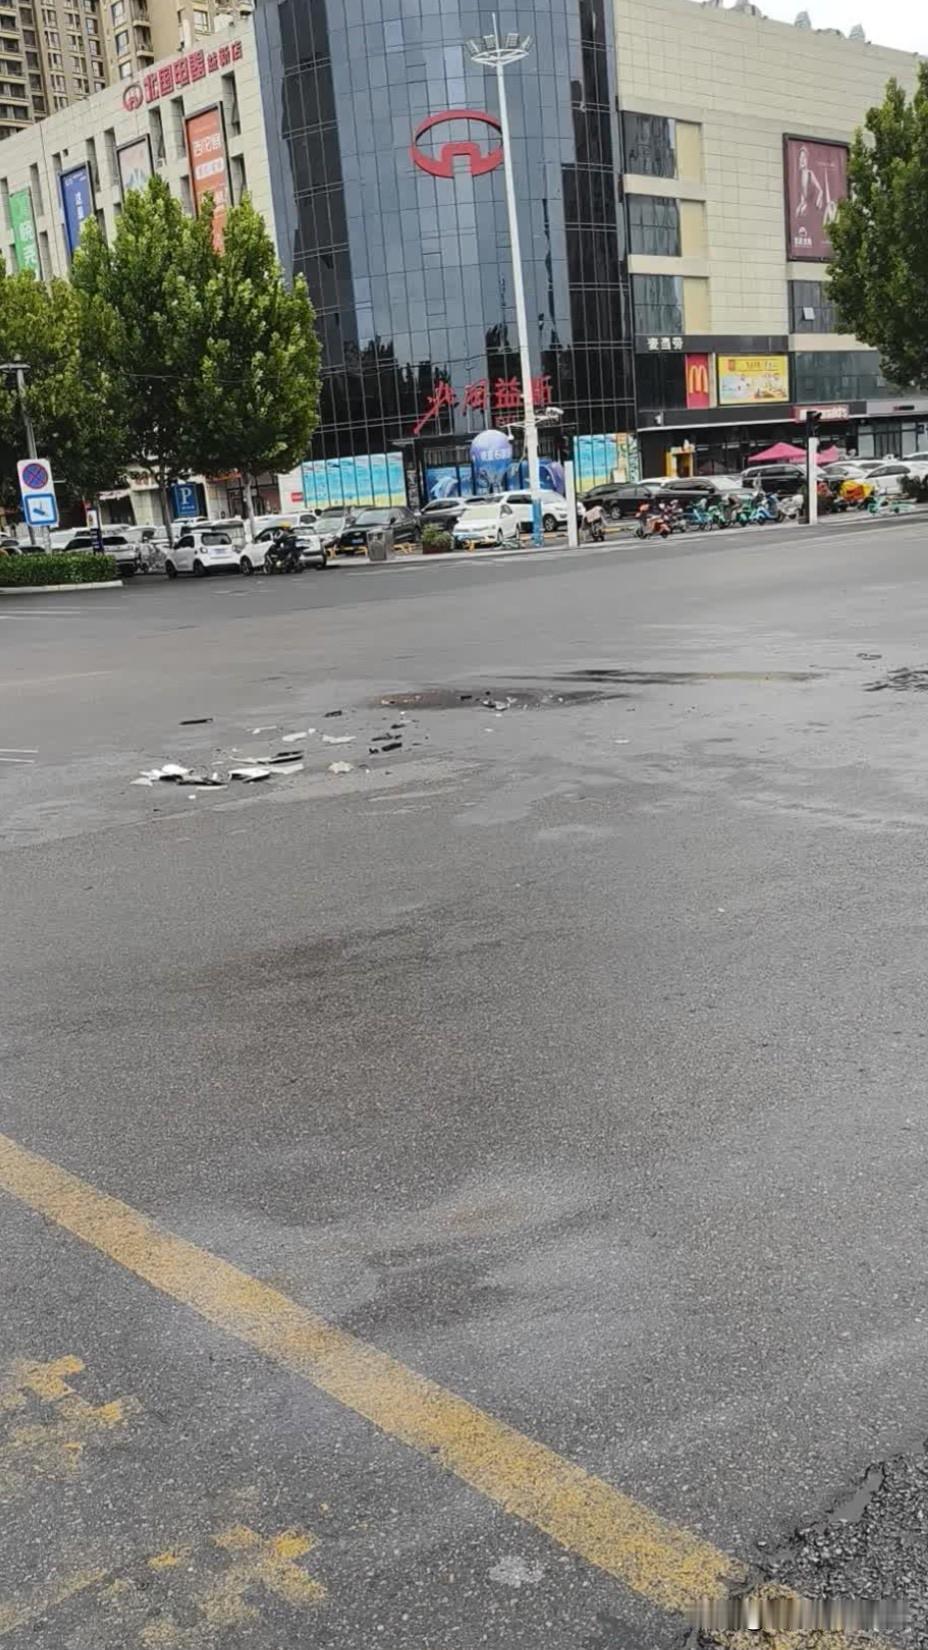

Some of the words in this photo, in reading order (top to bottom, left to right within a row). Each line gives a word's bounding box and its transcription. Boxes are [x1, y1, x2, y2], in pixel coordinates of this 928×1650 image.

[647, 337, 683, 351] 麦当劳
[179, 487, 192, 505] P
